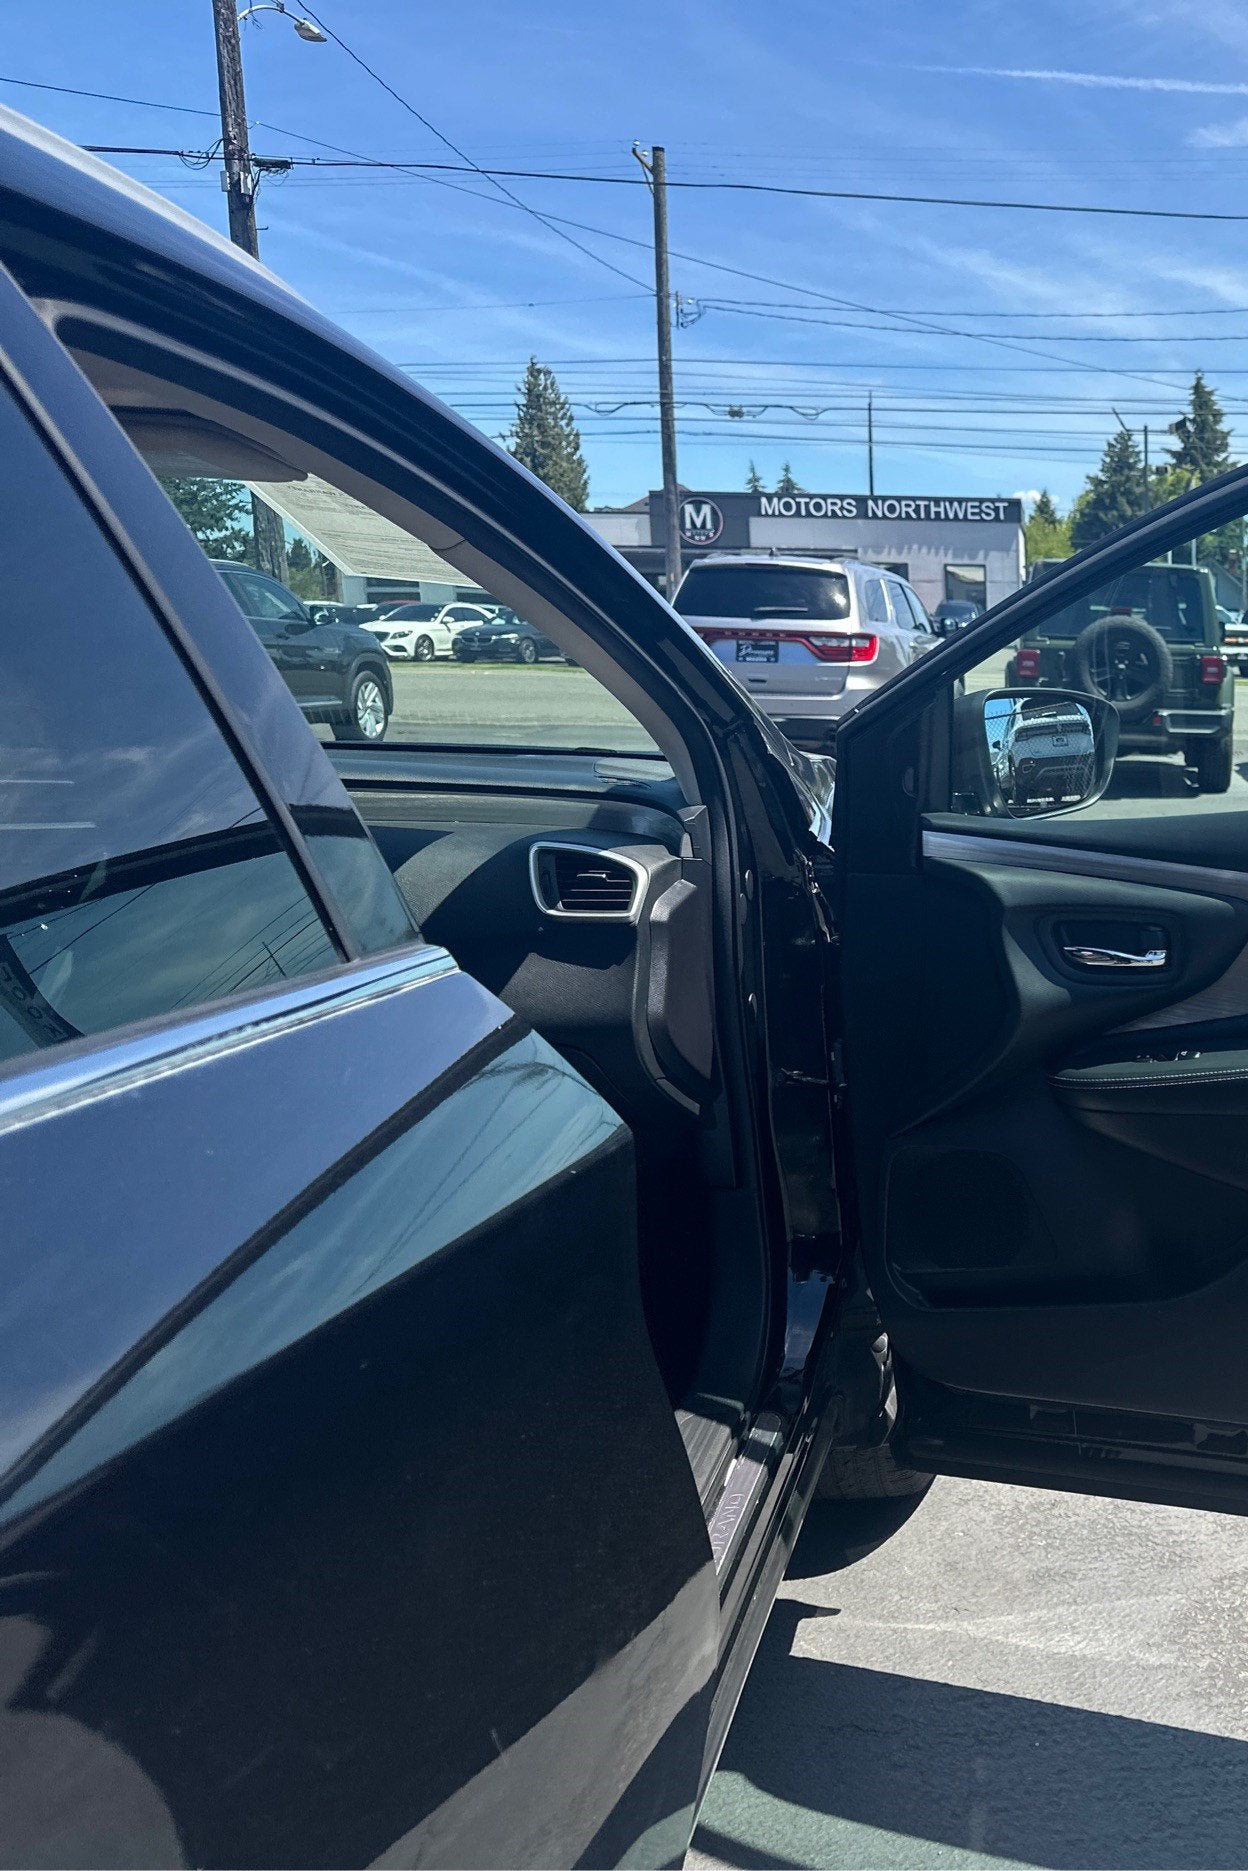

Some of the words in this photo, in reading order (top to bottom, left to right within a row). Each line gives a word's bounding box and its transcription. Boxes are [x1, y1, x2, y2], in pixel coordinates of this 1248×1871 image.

[684, 503, 712, 530] M
[760, 496, 858, 518] MOTORS
[867, 499, 1010, 521] NORTHWEST
